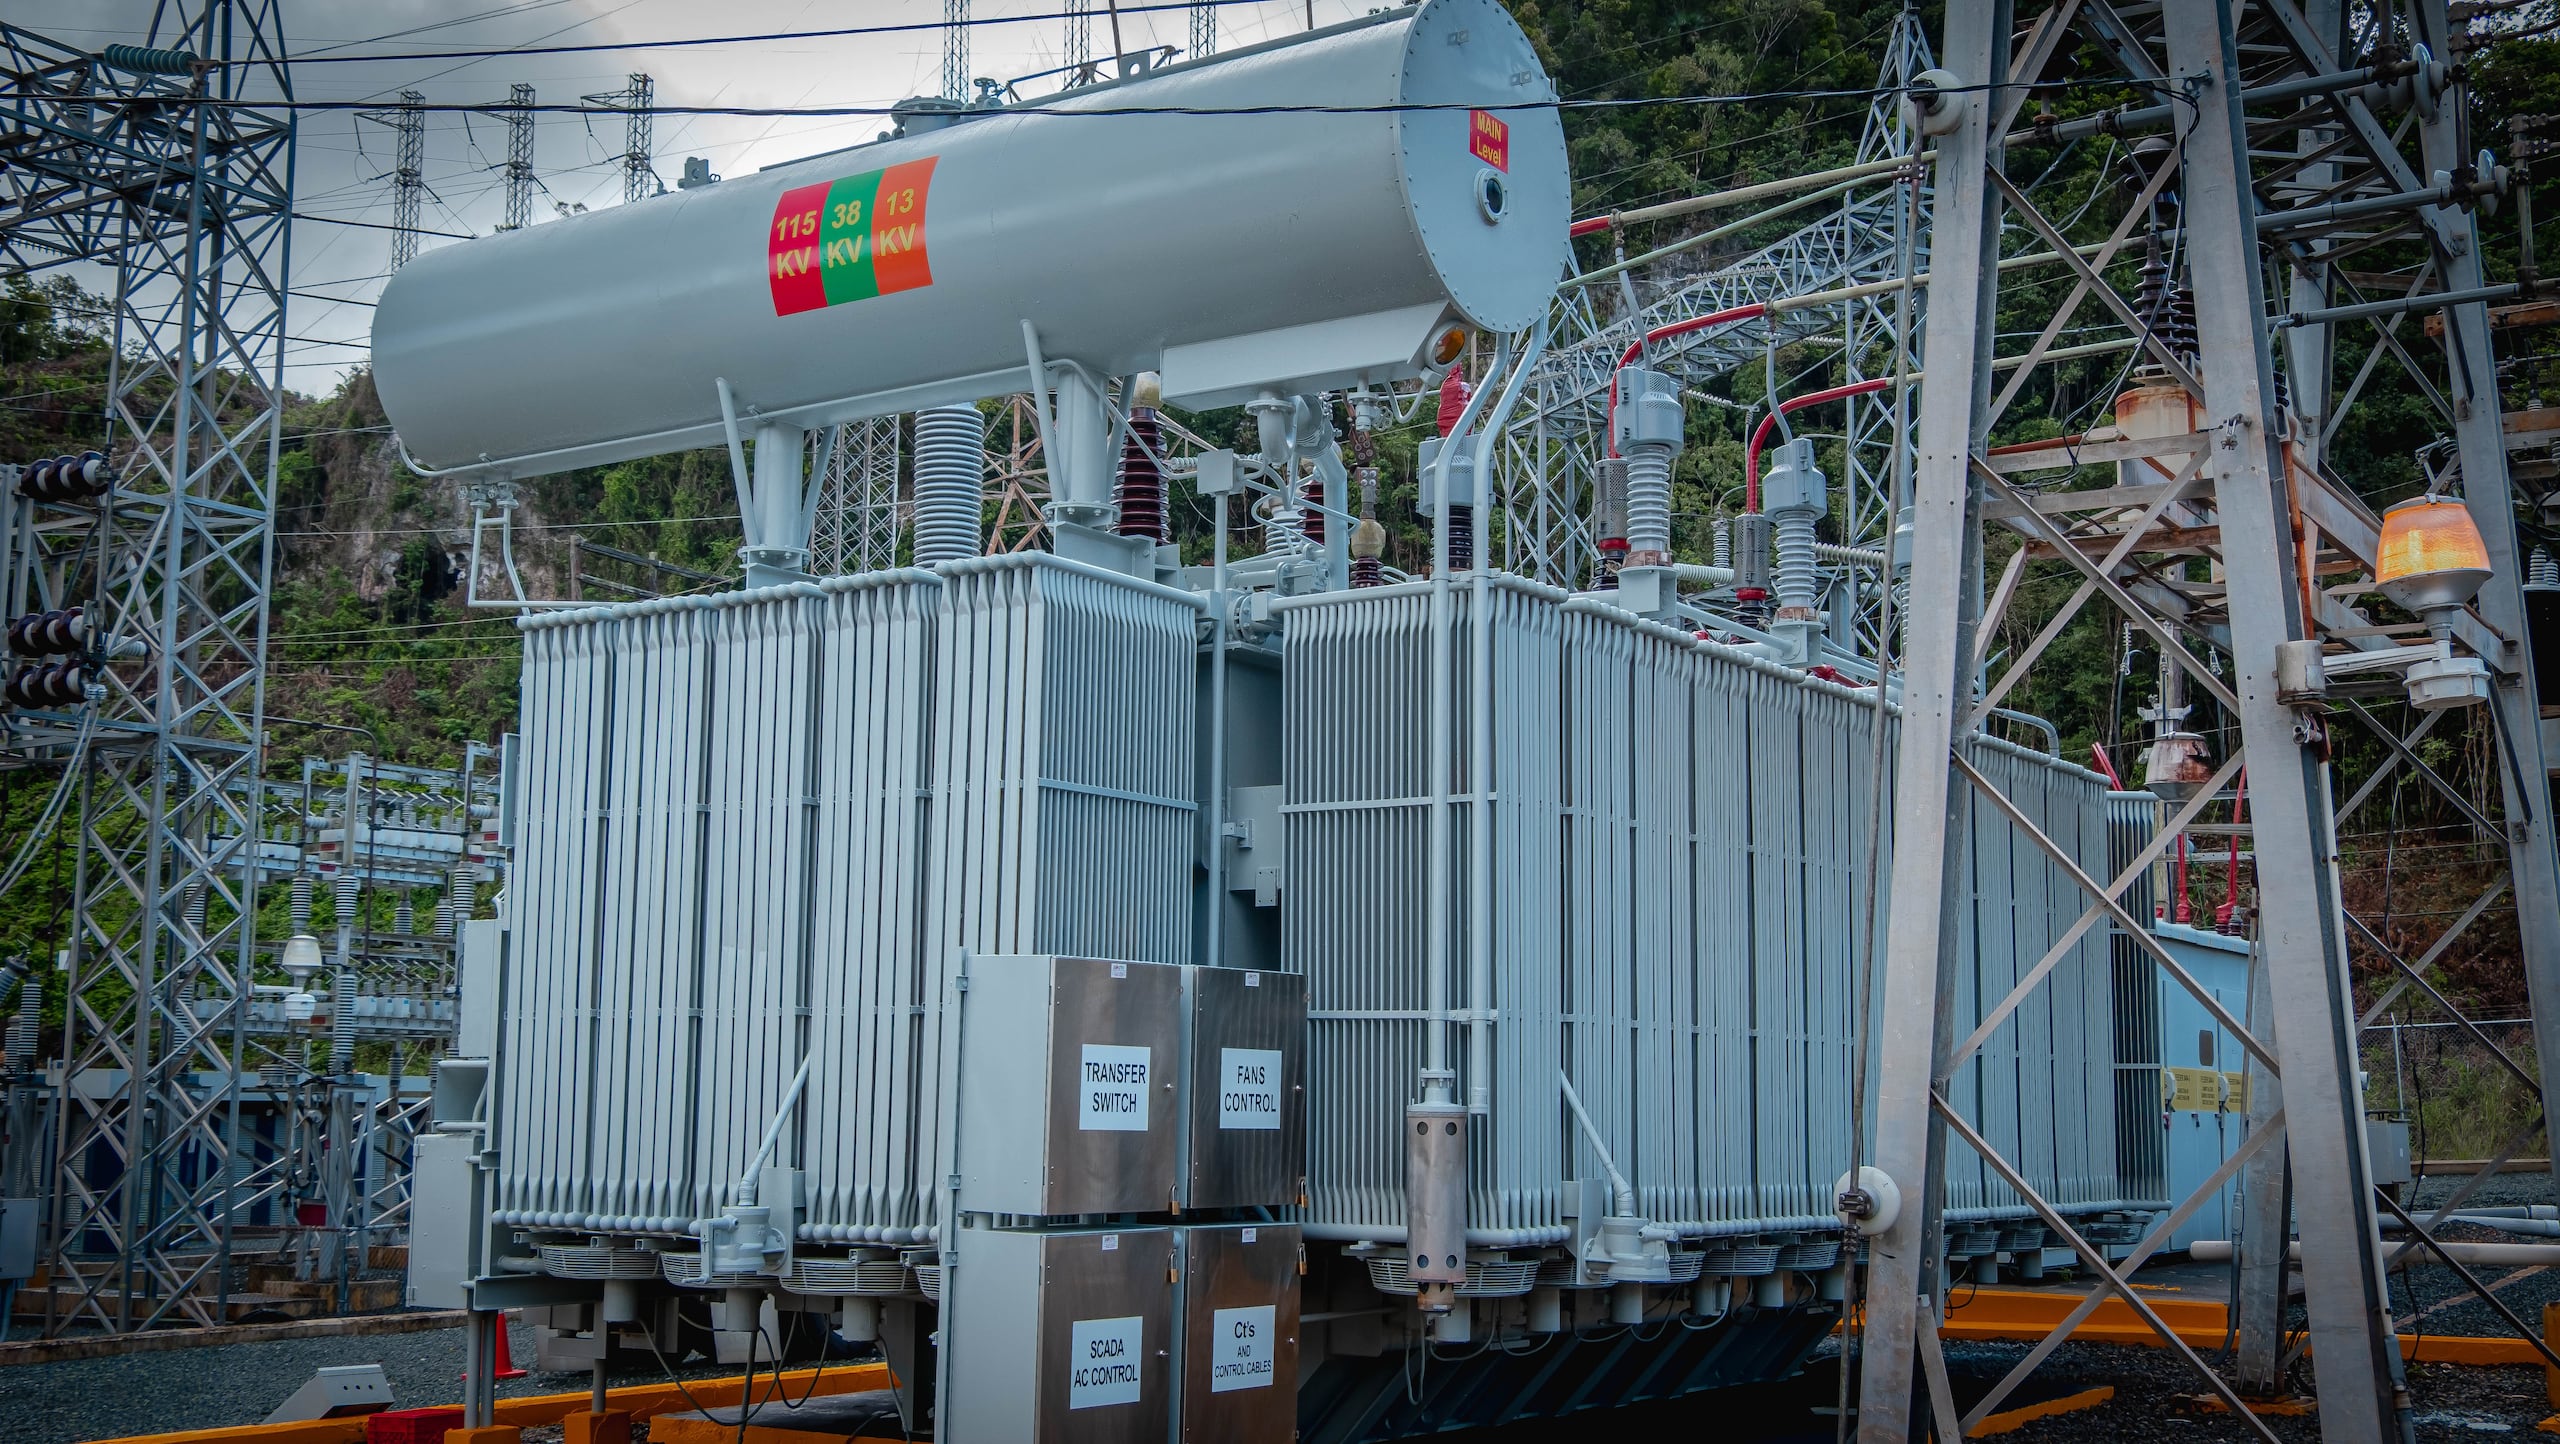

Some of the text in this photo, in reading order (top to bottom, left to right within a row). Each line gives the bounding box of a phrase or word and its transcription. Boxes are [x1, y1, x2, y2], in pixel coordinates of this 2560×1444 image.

[1477, 111, 1502, 142] MAIN
[1476, 135, 1501, 167] Level
[887, 188, 914, 216] 13
[777, 210, 817, 241] 115
[831, 200, 862, 229] 38
[827, 234, 863, 269] KV
[879, 223, 916, 257] KV
[776, 246, 812, 279] KV
[1085, 1062, 1146, 1084] TRANSFER
[1237, 1065, 1265, 1085] FANS
[1092, 1093, 1137, 1113] SWITCH
[1224, 1093, 1276, 1113] CONTROL
[1234, 1321, 1255, 1339] Ct's
[1090, 1338, 1124, 1359] SCADA
[1237, 1345, 1251, 1358] AND
[1074, 1364, 1138, 1388] AC CONTROL
[1215, 1360, 1272, 1379] CONTROL CABLES
